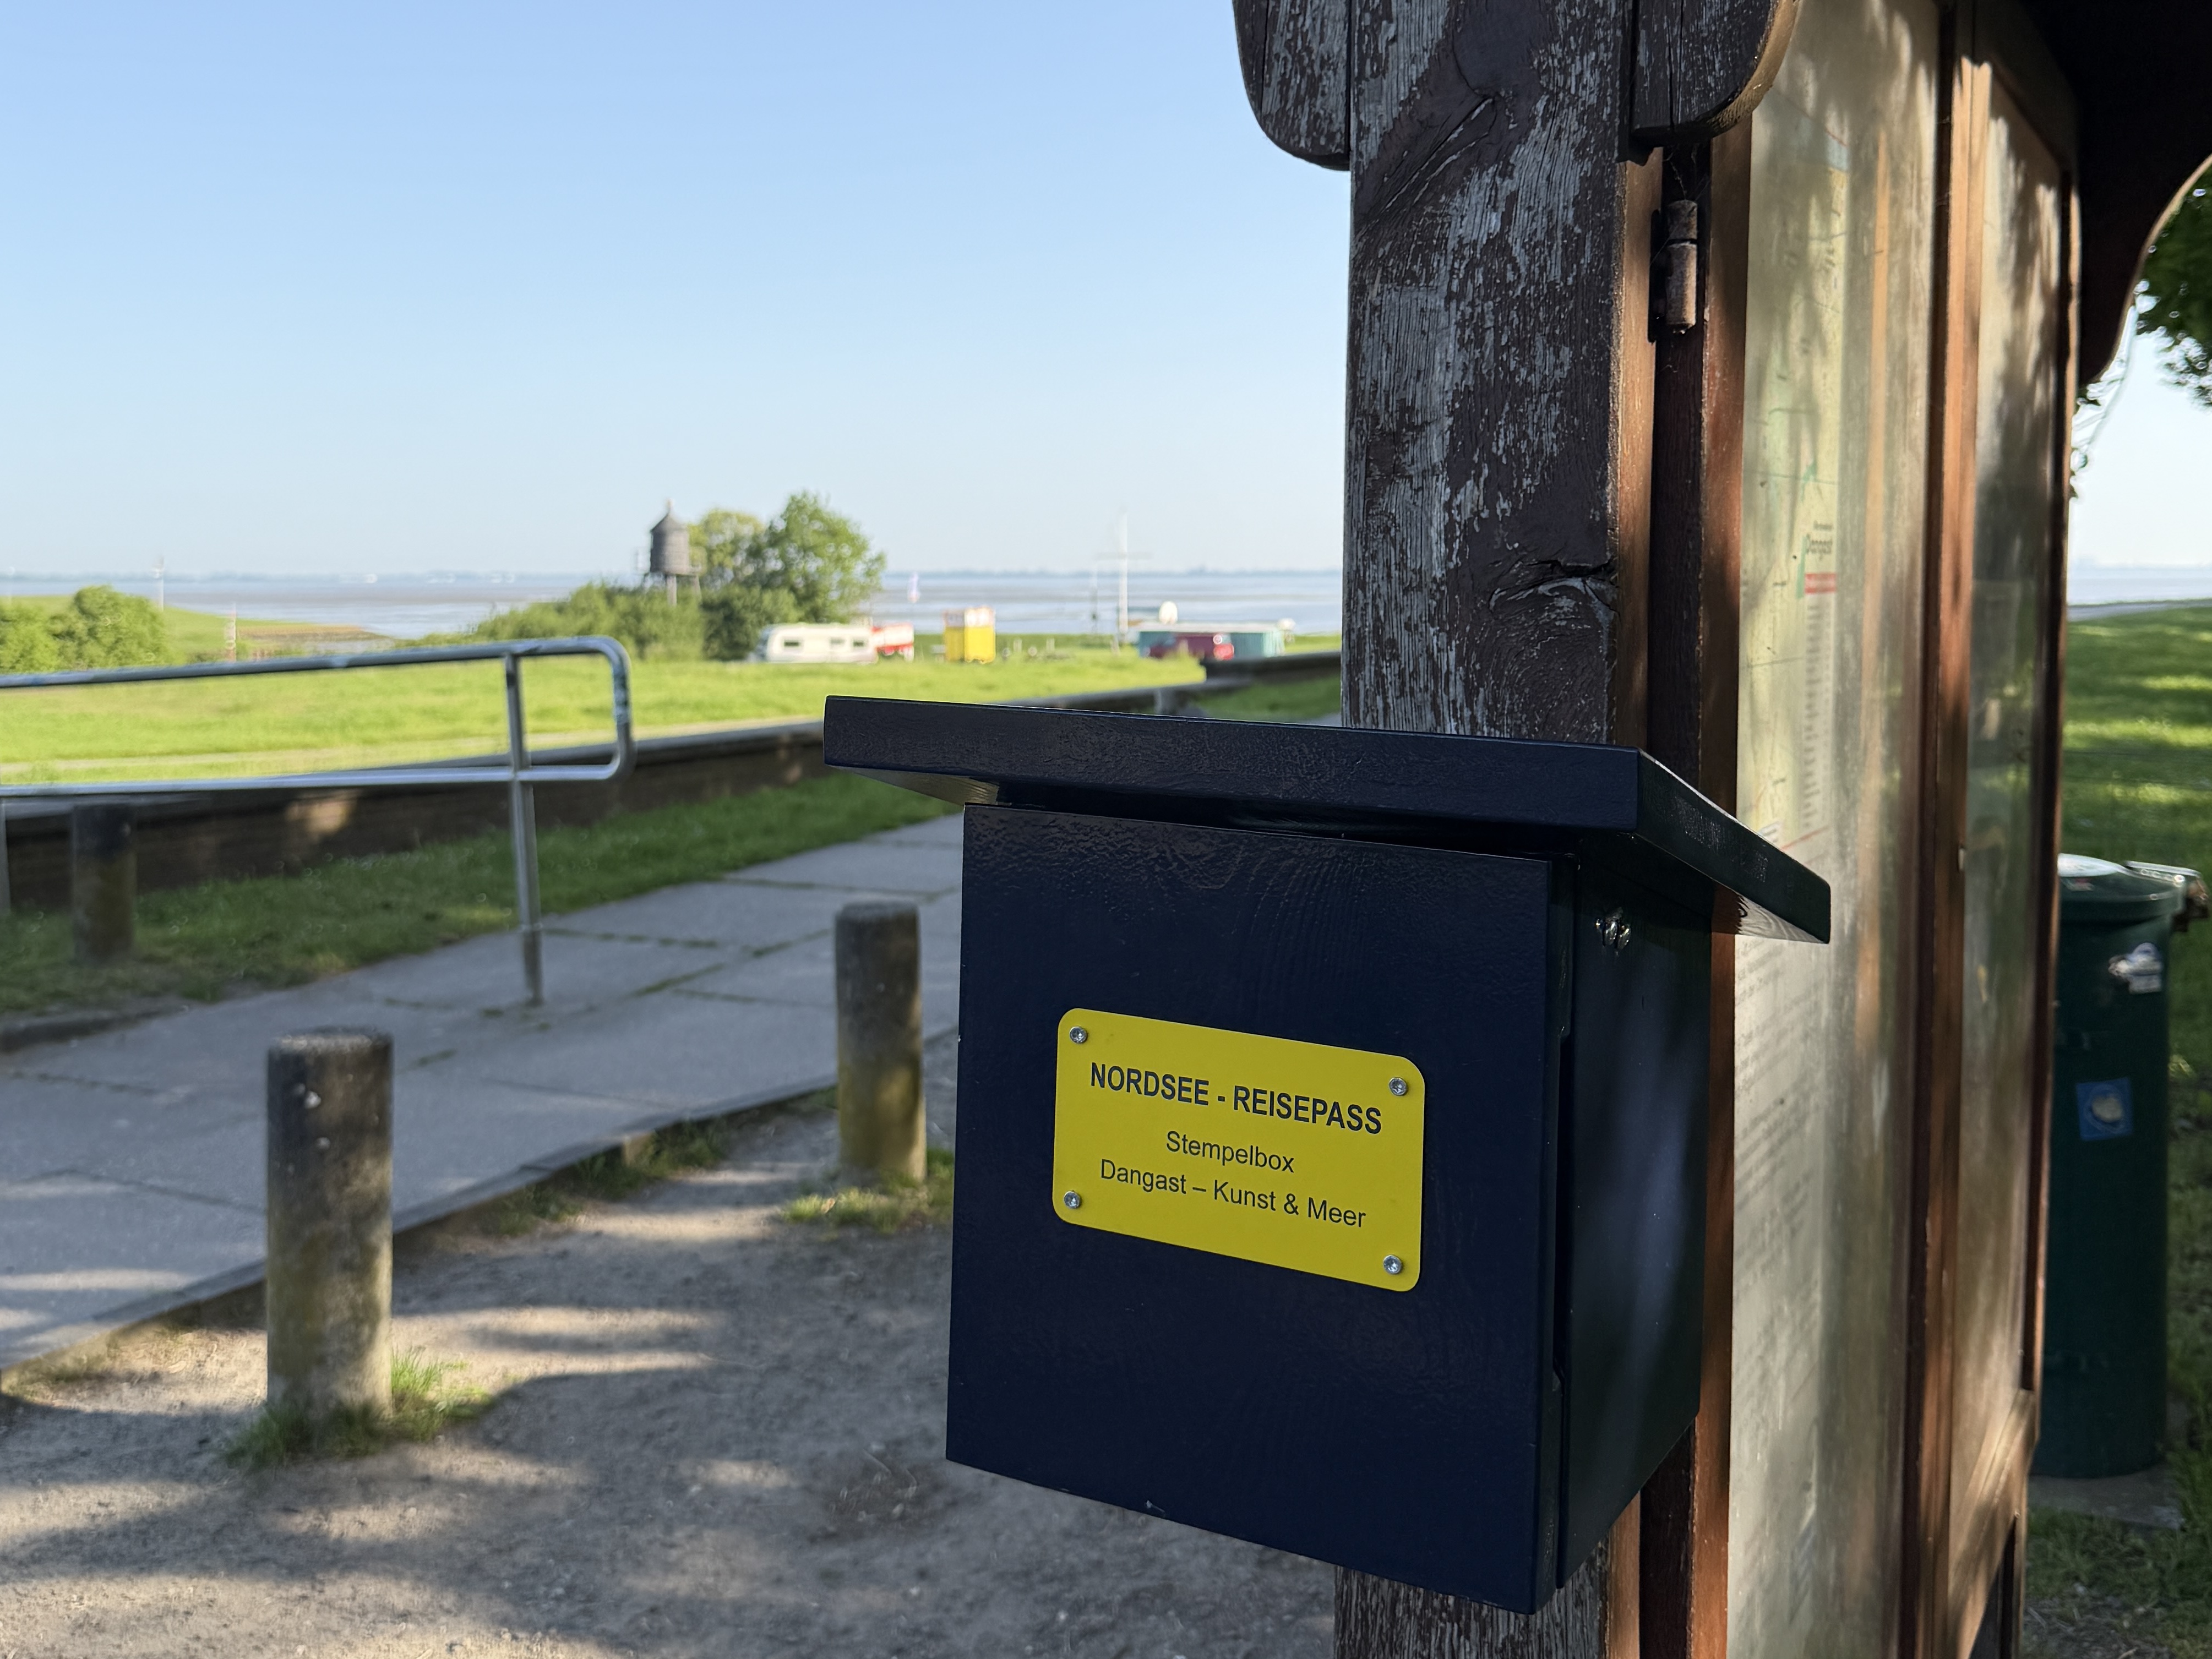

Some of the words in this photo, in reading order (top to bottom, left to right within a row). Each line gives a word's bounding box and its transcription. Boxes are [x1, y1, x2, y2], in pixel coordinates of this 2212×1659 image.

[1090, 1062, 1209, 1106] NORDSEE
[1233, 1085, 1382, 1134] REISEPASS
[1166, 1131, 1294, 1174] Stempelbox
[1100, 1158, 1187, 1194] Dangast
[1214, 1179, 1276, 1211] Kunst
[1283, 1193, 1299, 1215] &
[1307, 1197, 1366, 1228] Meer
